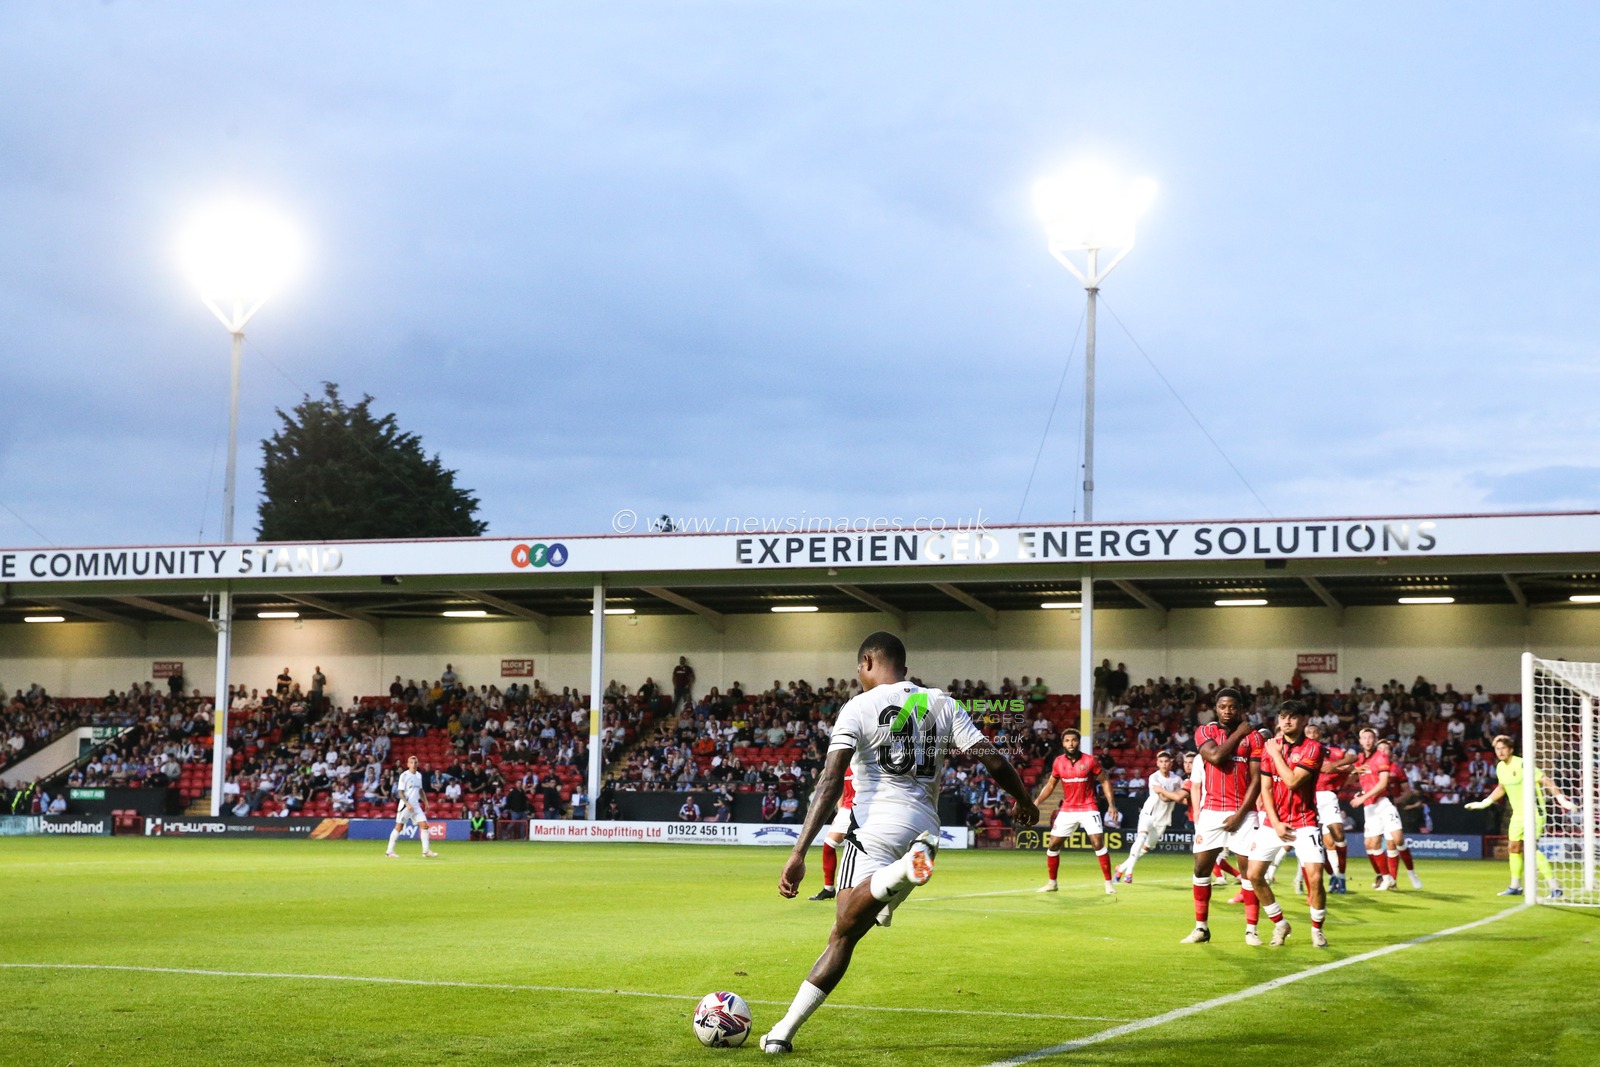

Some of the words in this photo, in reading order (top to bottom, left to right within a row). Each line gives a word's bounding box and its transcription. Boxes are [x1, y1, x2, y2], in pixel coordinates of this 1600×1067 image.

[736, 533, 1000, 564] EXPERIENCED
[1017, 529, 1179, 559] ENERGY
[1193, 521, 1438, 556] SOLUTIONS
[29, 550, 226, 576] COMMUNITY
[237, 547, 343, 574] STAND
[523, 660, 532, 674] F
[40, 820, 104, 833] Poundland
[163, 822, 226, 832] HAYWARD
[534, 825, 565, 836] Martin
[568, 826, 588, 836] Hart
[590, 826, 644, 839] Shopfitting
[646, 827, 662, 837] Ltd
[667, 824, 697, 836] 01922
[700, 825, 718, 836] 456
[721, 826, 738, 836] 111
[1159, 843, 1185, 851] YOUR
[1404, 837, 1469, 852] Contracting
